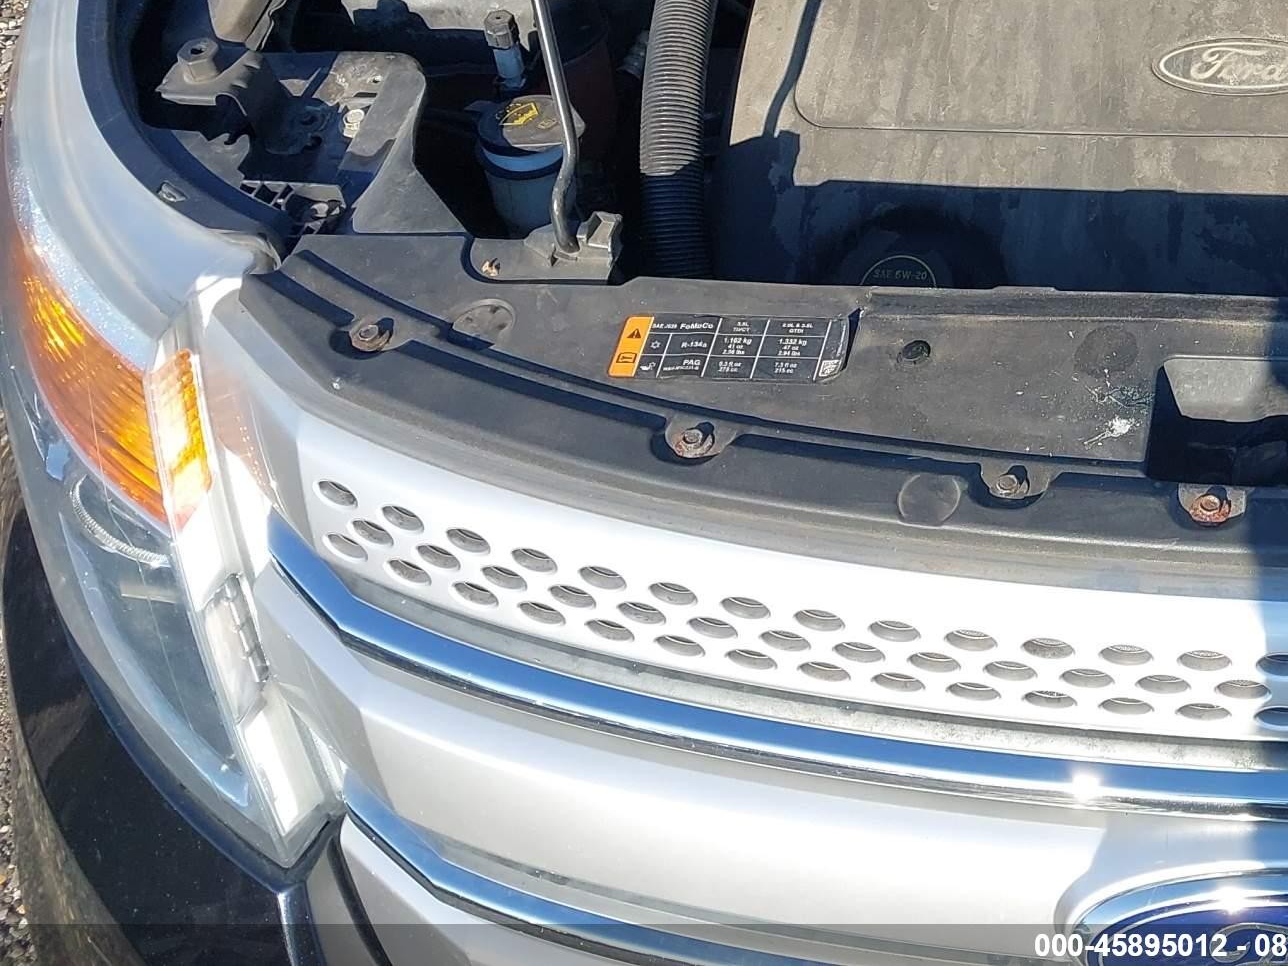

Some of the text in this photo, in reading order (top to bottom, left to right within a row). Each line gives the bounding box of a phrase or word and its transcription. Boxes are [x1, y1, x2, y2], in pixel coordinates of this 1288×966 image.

[872, 269, 928, 280] SAE 5W-20
[680, 322, 714, 330] FoMoCo
[681, 340, 707, 348] R-134a
[743, 337, 752, 345] kg
[798, 338, 807, 346] kg
